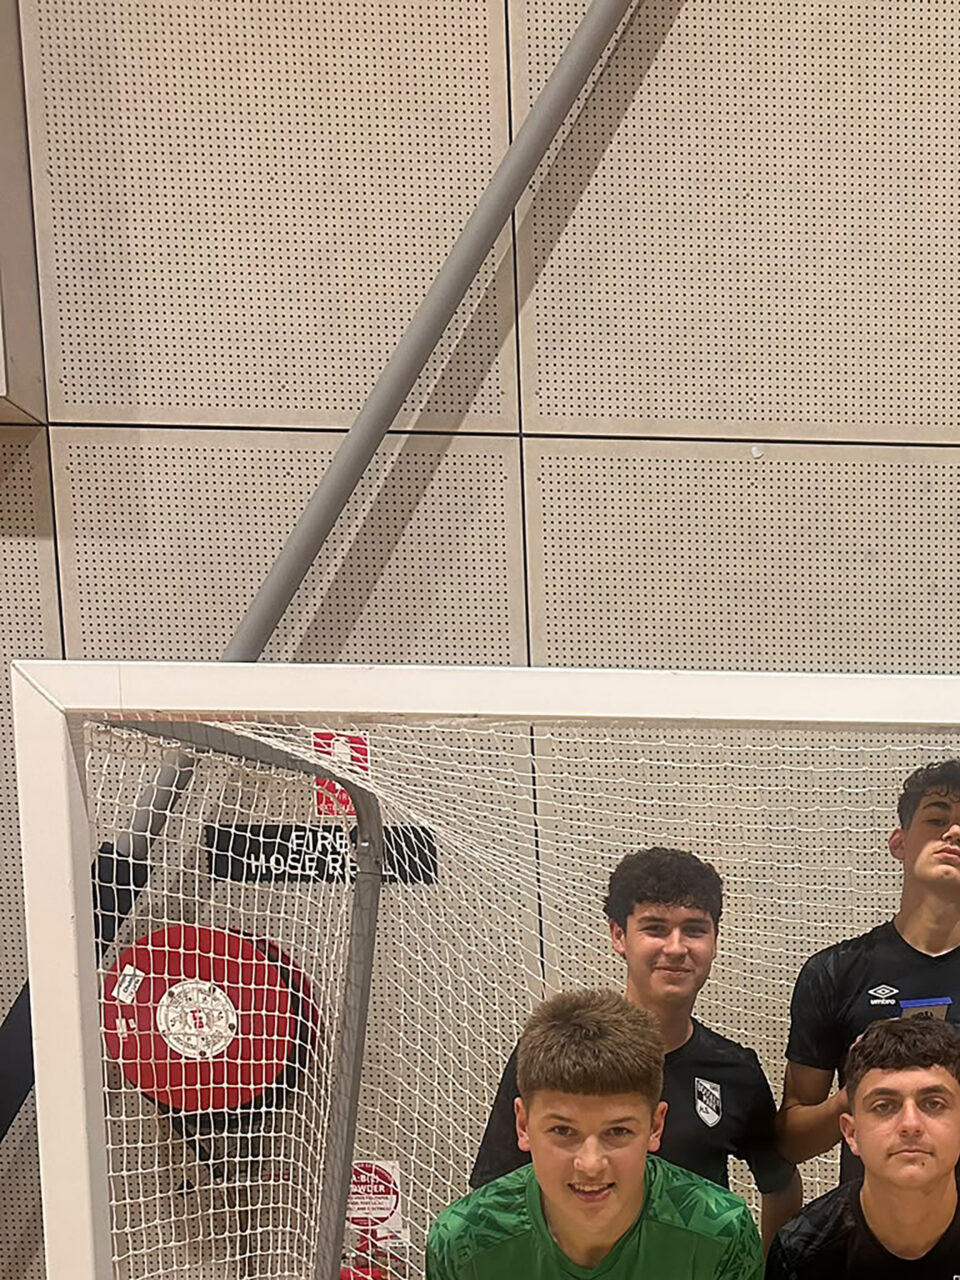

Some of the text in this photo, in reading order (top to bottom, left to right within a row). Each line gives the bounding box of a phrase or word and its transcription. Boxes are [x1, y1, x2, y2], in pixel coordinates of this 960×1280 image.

[292, 831, 349, 852] FIRE
[250, 853, 319, 875] HOSE
[350, 1184, 386, 1193] OWDER
